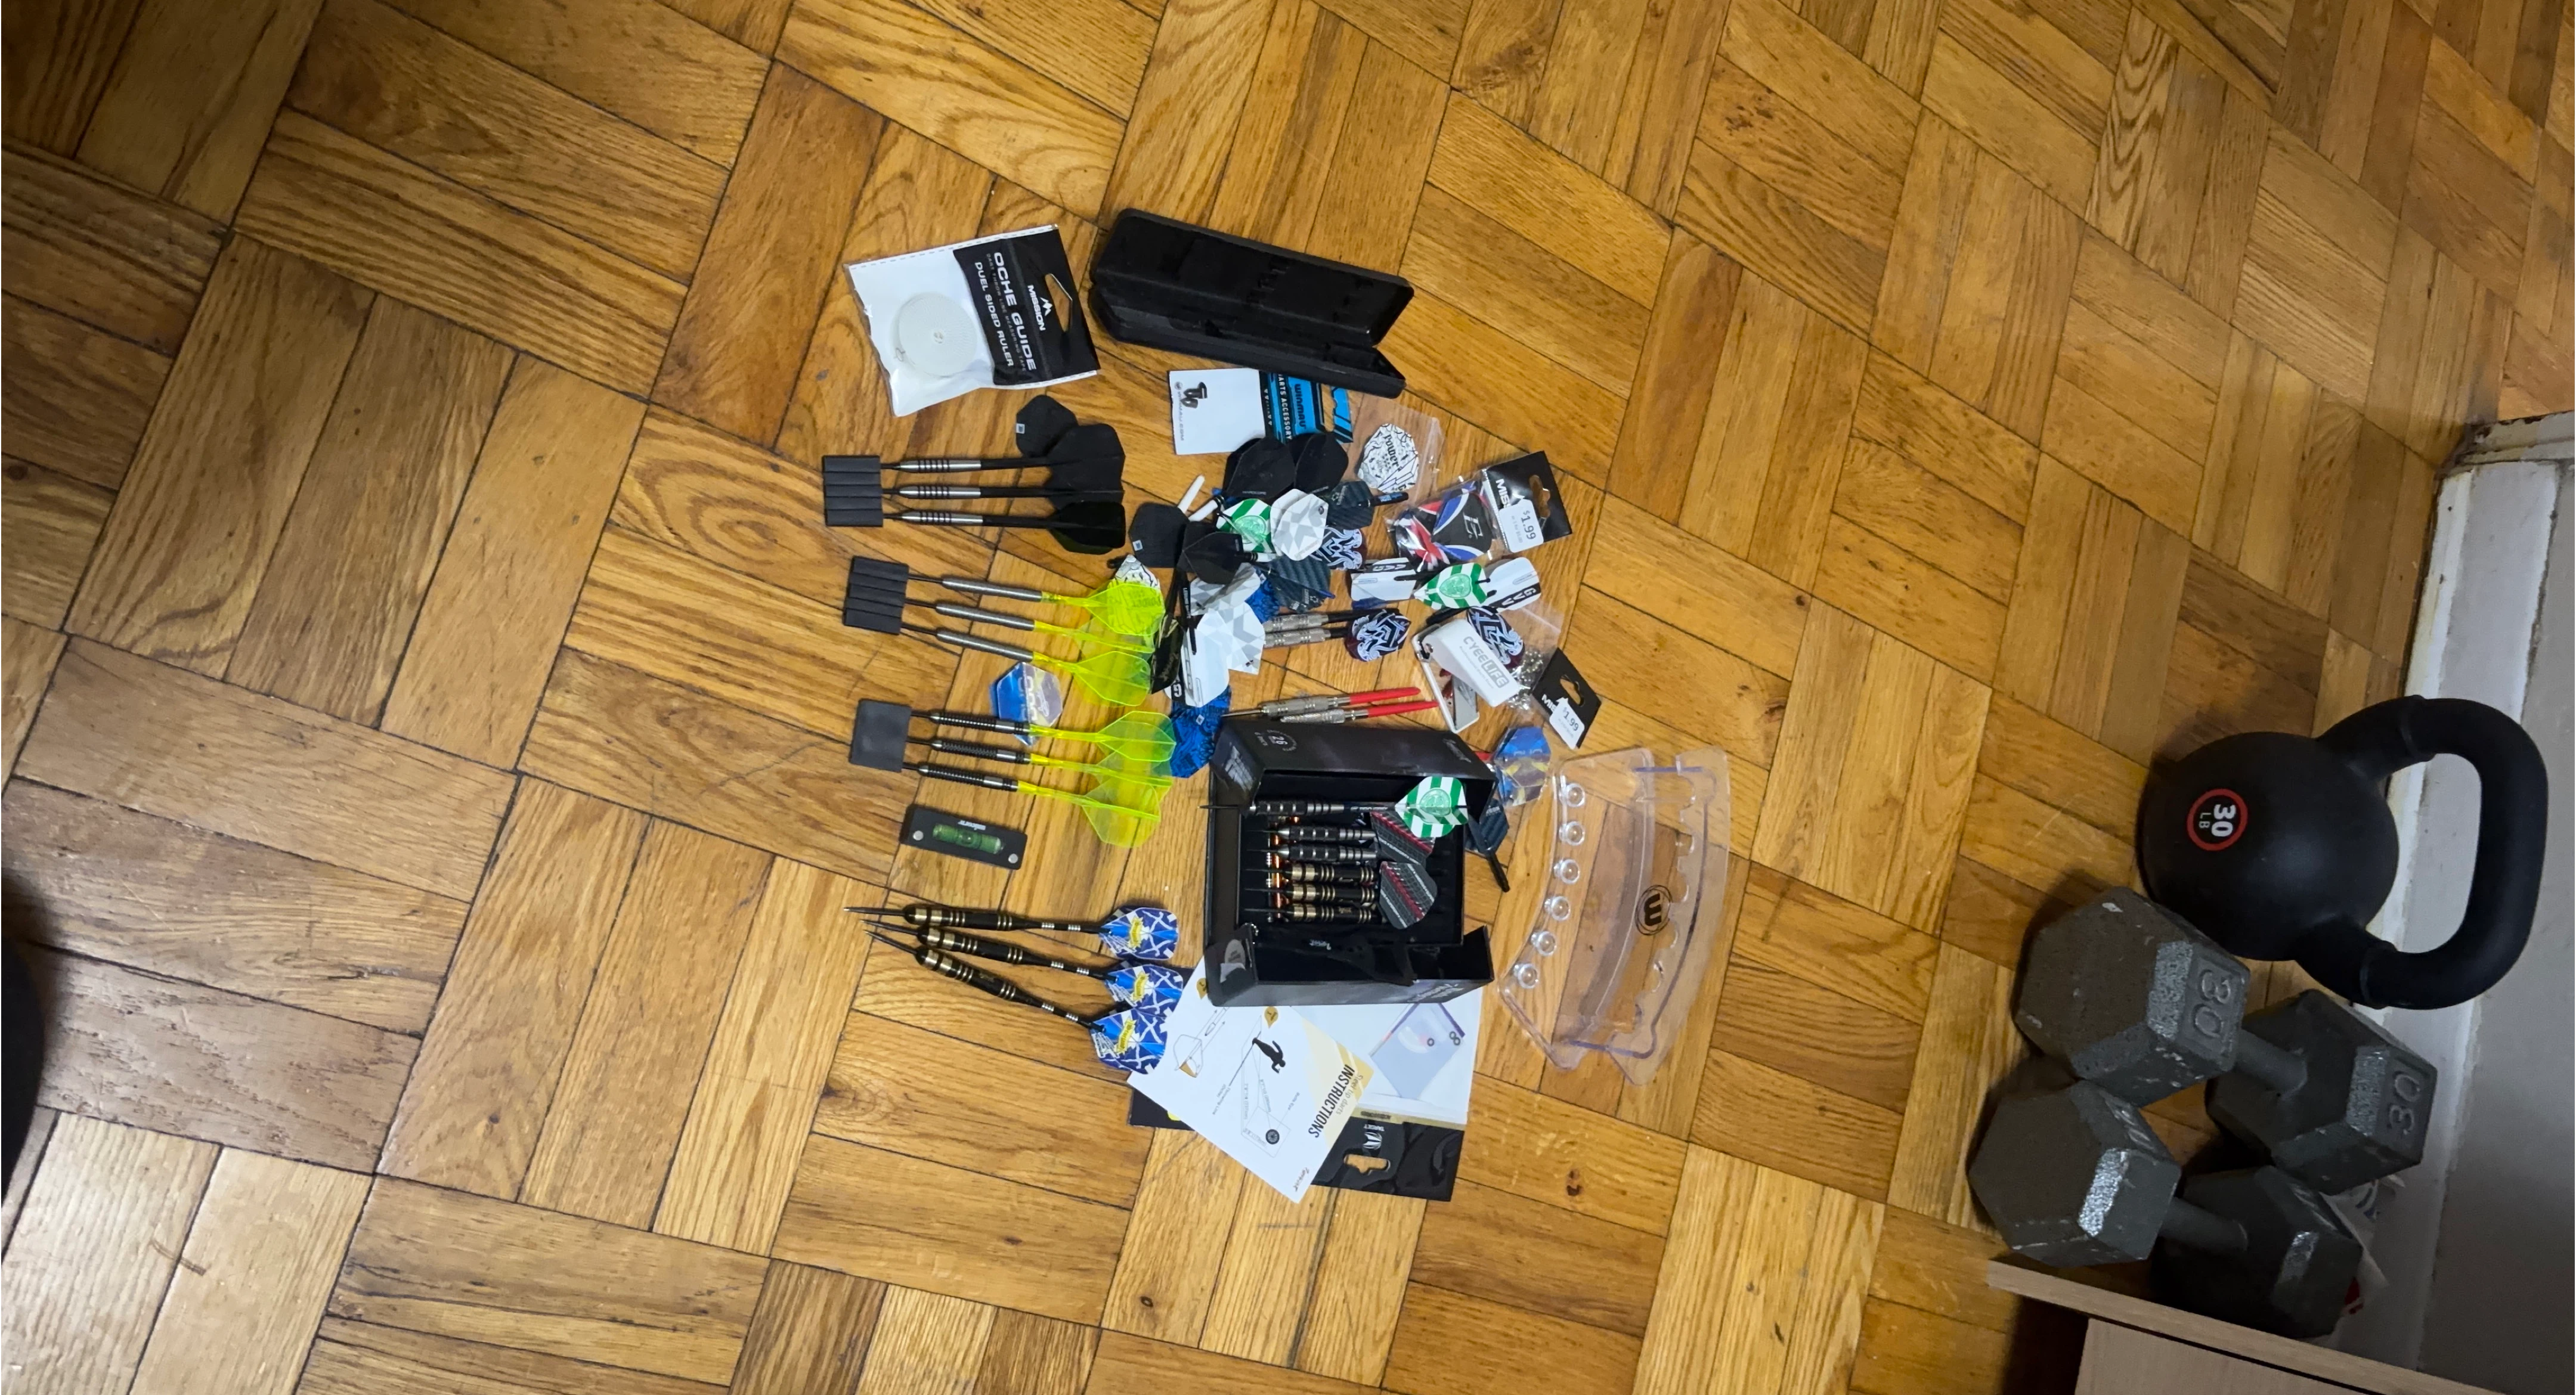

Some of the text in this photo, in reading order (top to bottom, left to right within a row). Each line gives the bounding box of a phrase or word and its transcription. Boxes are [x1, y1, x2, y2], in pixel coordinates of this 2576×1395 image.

[975, 262, 1014, 367] DUEL SIDED RULER
[992, 272, 1001, 296] THROW
[1005, 315, 1020, 354] MEASURING
[994, 252, 1036, 371] OCHE GUIDE
[1027, 284, 1046, 331] MISSION
[1281, 397, 1293, 440] ACCESSORY
[1521, 510, 1537, 540] $1.99
[1463, 636, 1509, 688] CYEELIFE
[1562, 706, 1579, 731] $1.99
[2199, 811, 2210, 830] LB
[2211, 803, 2237, 838] 30
[2191, 969, 2232, 1040] 30
[1306, 1064, 1356, 1139] INSTRUCTIONS
[1335, 1072, 1364, 1116] Steel tip darts
[2388, 1073, 2420, 1136] 30
